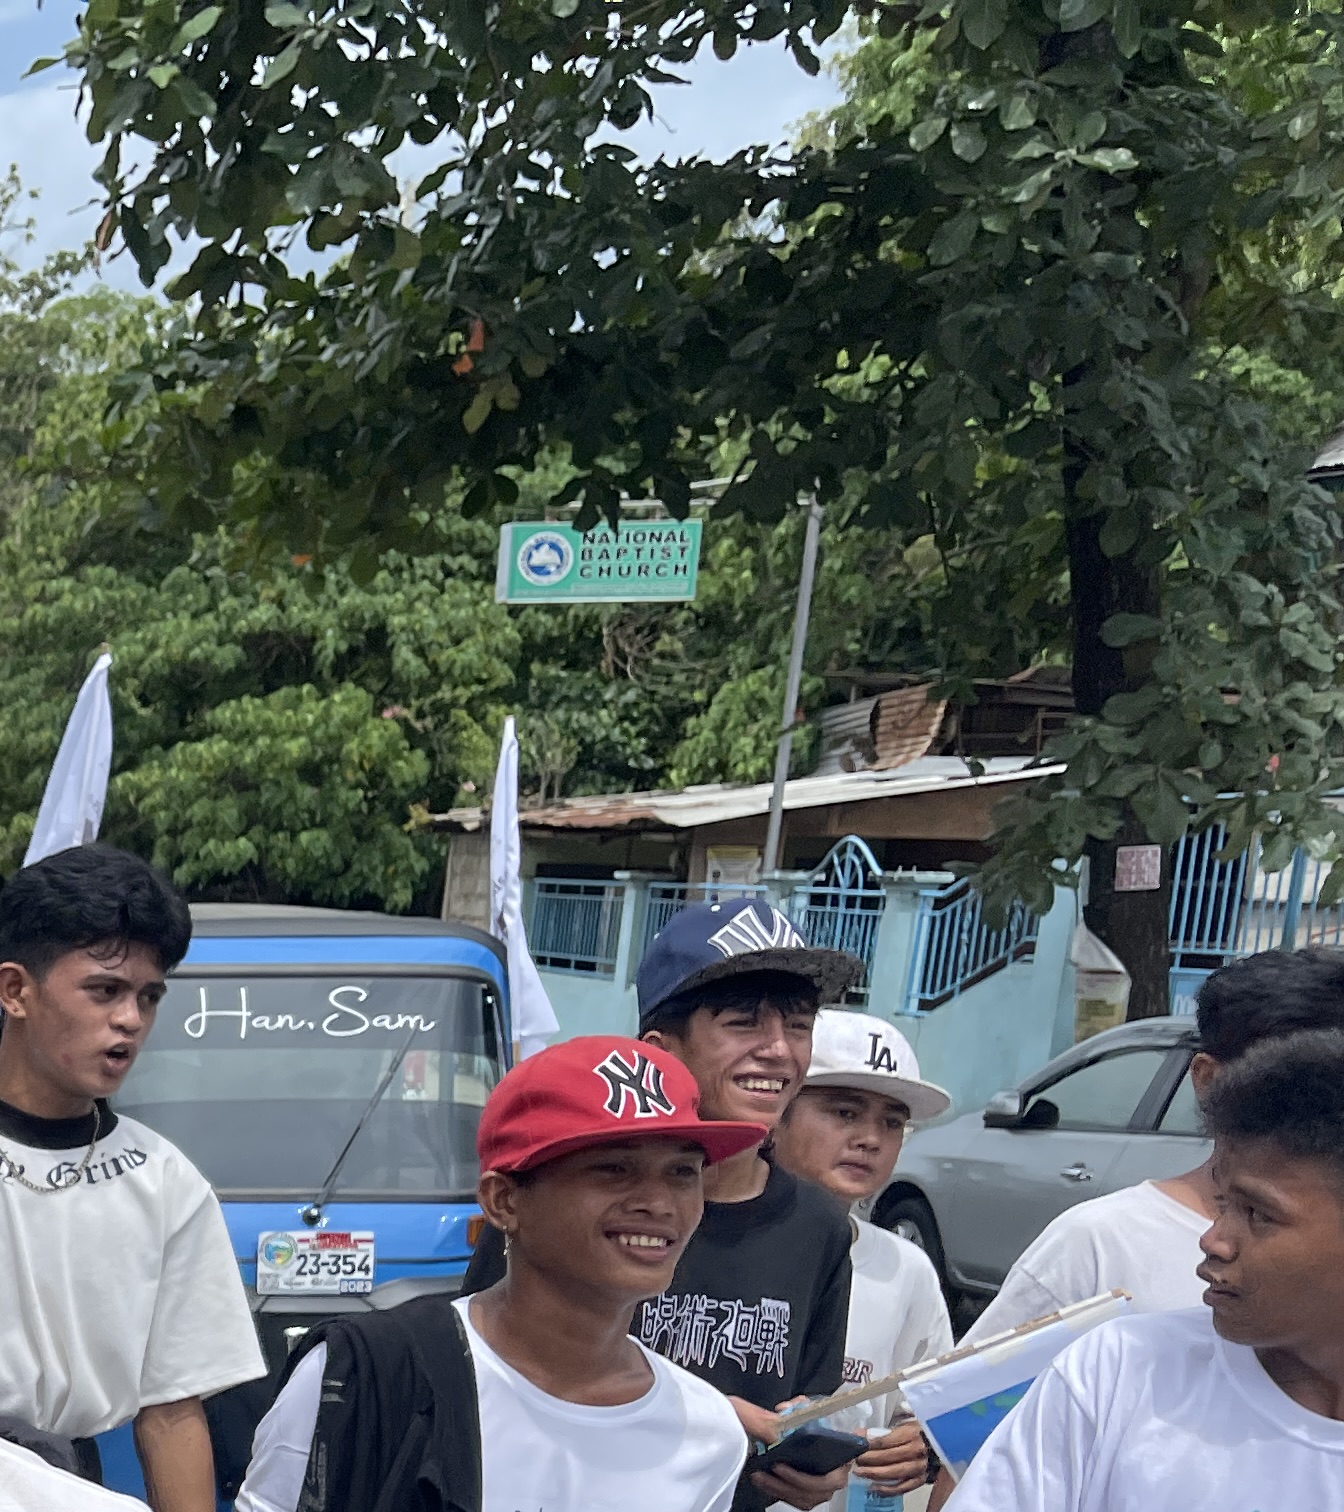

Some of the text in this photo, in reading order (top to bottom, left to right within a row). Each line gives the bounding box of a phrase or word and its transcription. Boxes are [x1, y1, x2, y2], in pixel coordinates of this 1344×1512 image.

[582, 530, 690, 546] NATIONAL
[581, 547, 689, 561] BAPTIST
[580, 564, 688, 578] CHURCH
[864, 1032, 897, 1072] LA
[593, 1048, 676, 1119] NY
[46, 1147, 147, 1189] Grind
[295, 1253, 370, 1276] 23-354
